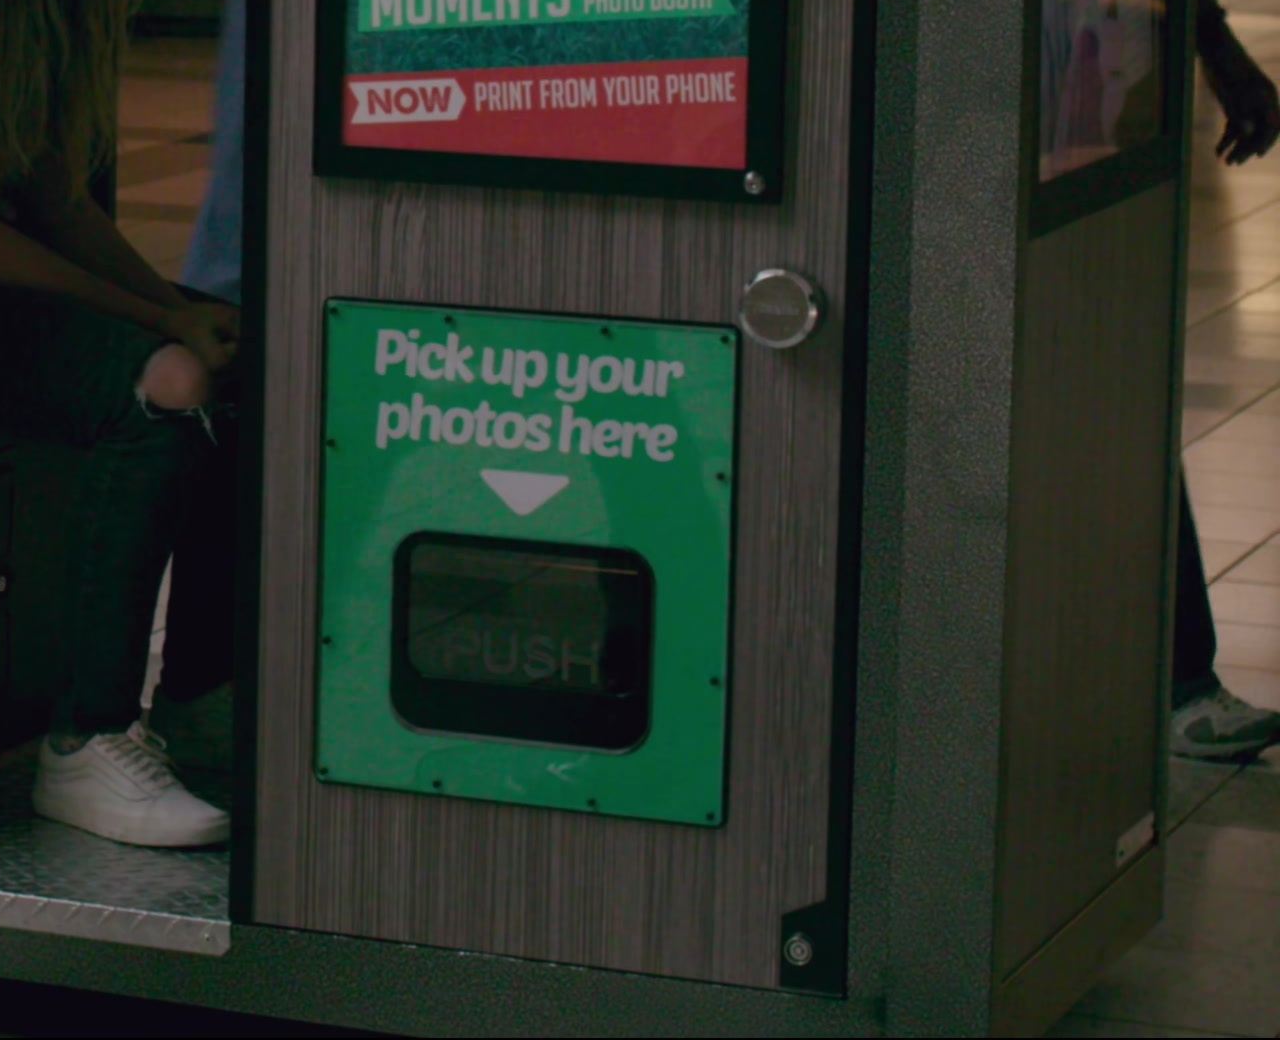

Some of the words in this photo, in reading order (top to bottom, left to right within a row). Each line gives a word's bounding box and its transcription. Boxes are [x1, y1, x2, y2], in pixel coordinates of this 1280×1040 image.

[367, 85, 453, 116] NOW
[474, 80, 533, 112] PRINT
[540, 78, 597, 110] FROM
[603, 75, 660, 107] YOUR
[666, 71, 737, 104] PHONE
[374, 328, 476, 383] Pick
[481, 346, 548, 398] up
[555, 352, 685, 403] your
[376, 392, 552, 453] photos
[559, 405, 679, 462] here
[443, 628, 601, 687] PUSH
